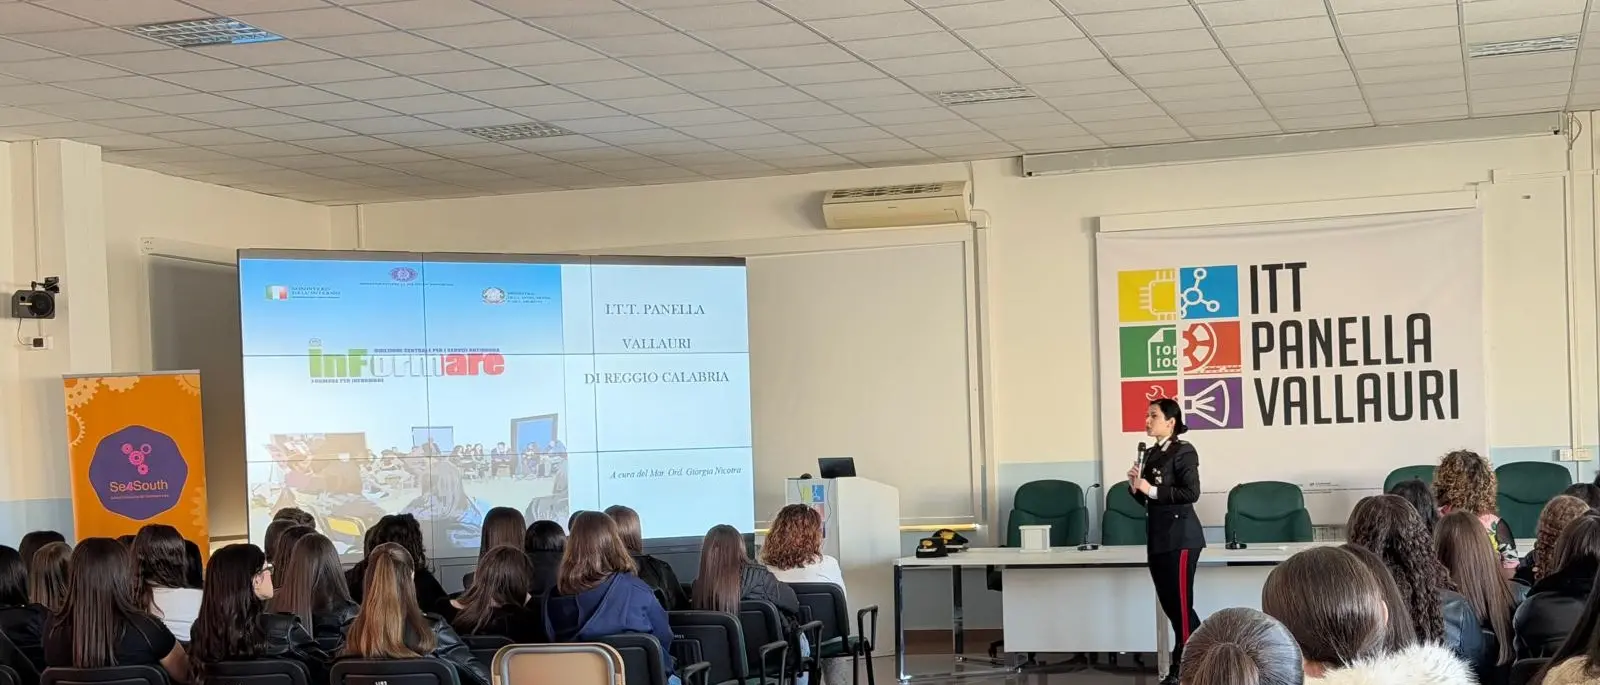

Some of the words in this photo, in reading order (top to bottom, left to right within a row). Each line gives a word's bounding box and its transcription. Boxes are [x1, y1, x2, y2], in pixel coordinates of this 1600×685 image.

[1249, 262, 1308, 315] ITT
[643, 303, 706, 315] PANELLA
[622, 338, 691, 349] VALLAURI
[1251, 312, 1433, 371] PANELLA
[585, 373, 600, 384] DI
[604, 372, 659, 384] REGGIO
[662, 371, 730, 383] CALABRIA
[1253, 368, 1460, 427] VALLAURI
[637, 469, 649, 478] del
[686, 467, 713, 478] Giorgia
[714, 466, 742, 476] Nicotra
[110, 479, 169, 492] Se4South
